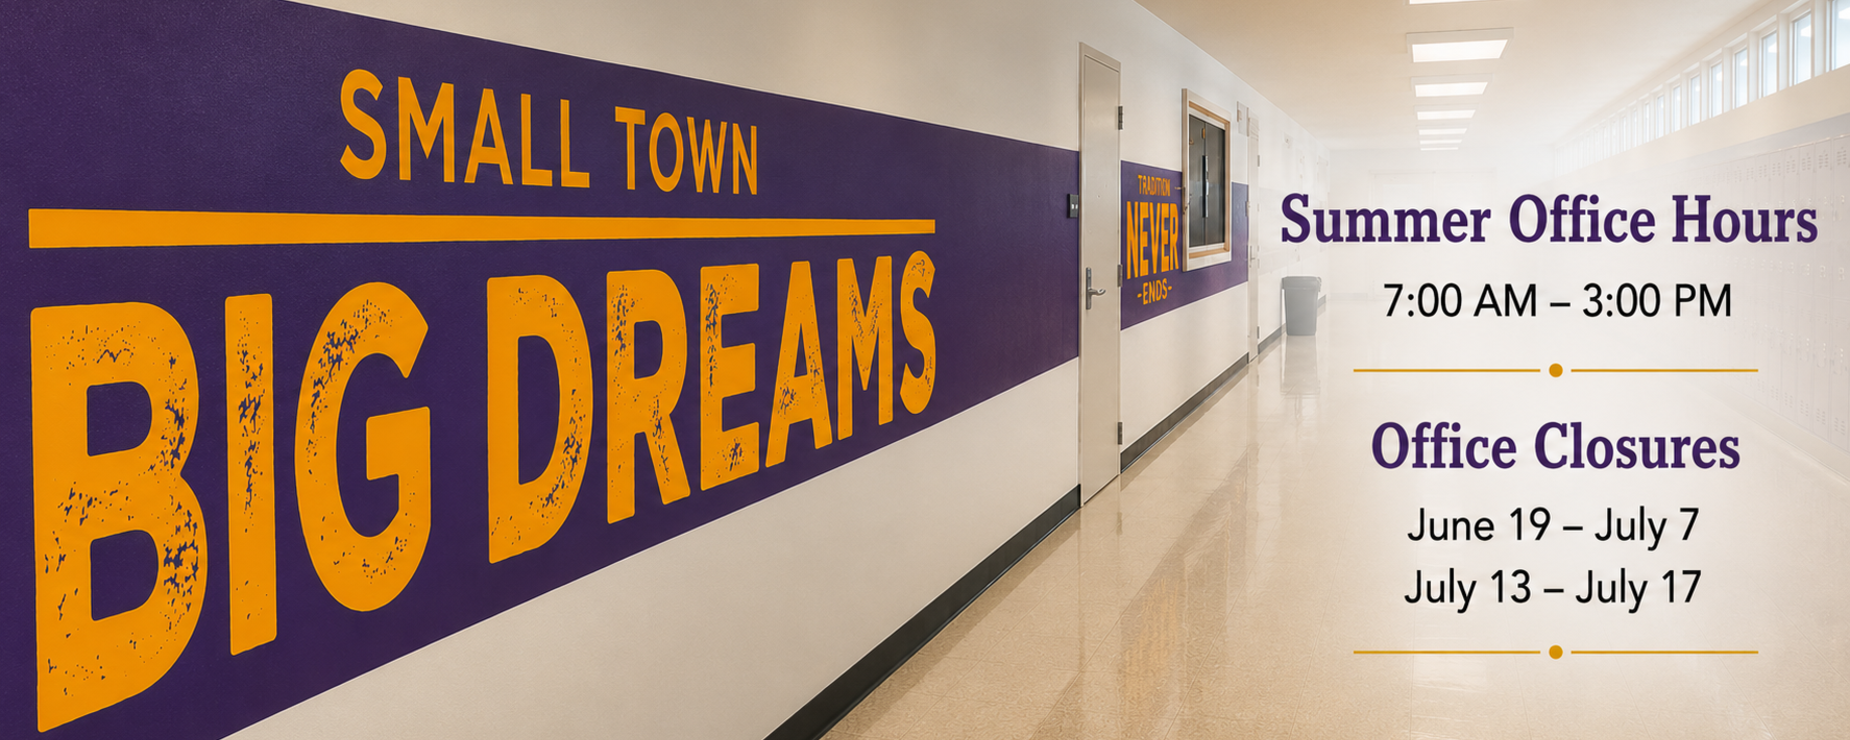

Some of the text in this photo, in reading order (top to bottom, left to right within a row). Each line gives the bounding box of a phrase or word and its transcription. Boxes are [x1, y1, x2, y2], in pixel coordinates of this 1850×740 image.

[340, 69, 758, 195] SMALL TOWN
[1126, 201, 1179, 280] NEVER
[30, 250, 937, 733] BIG DREAMS
